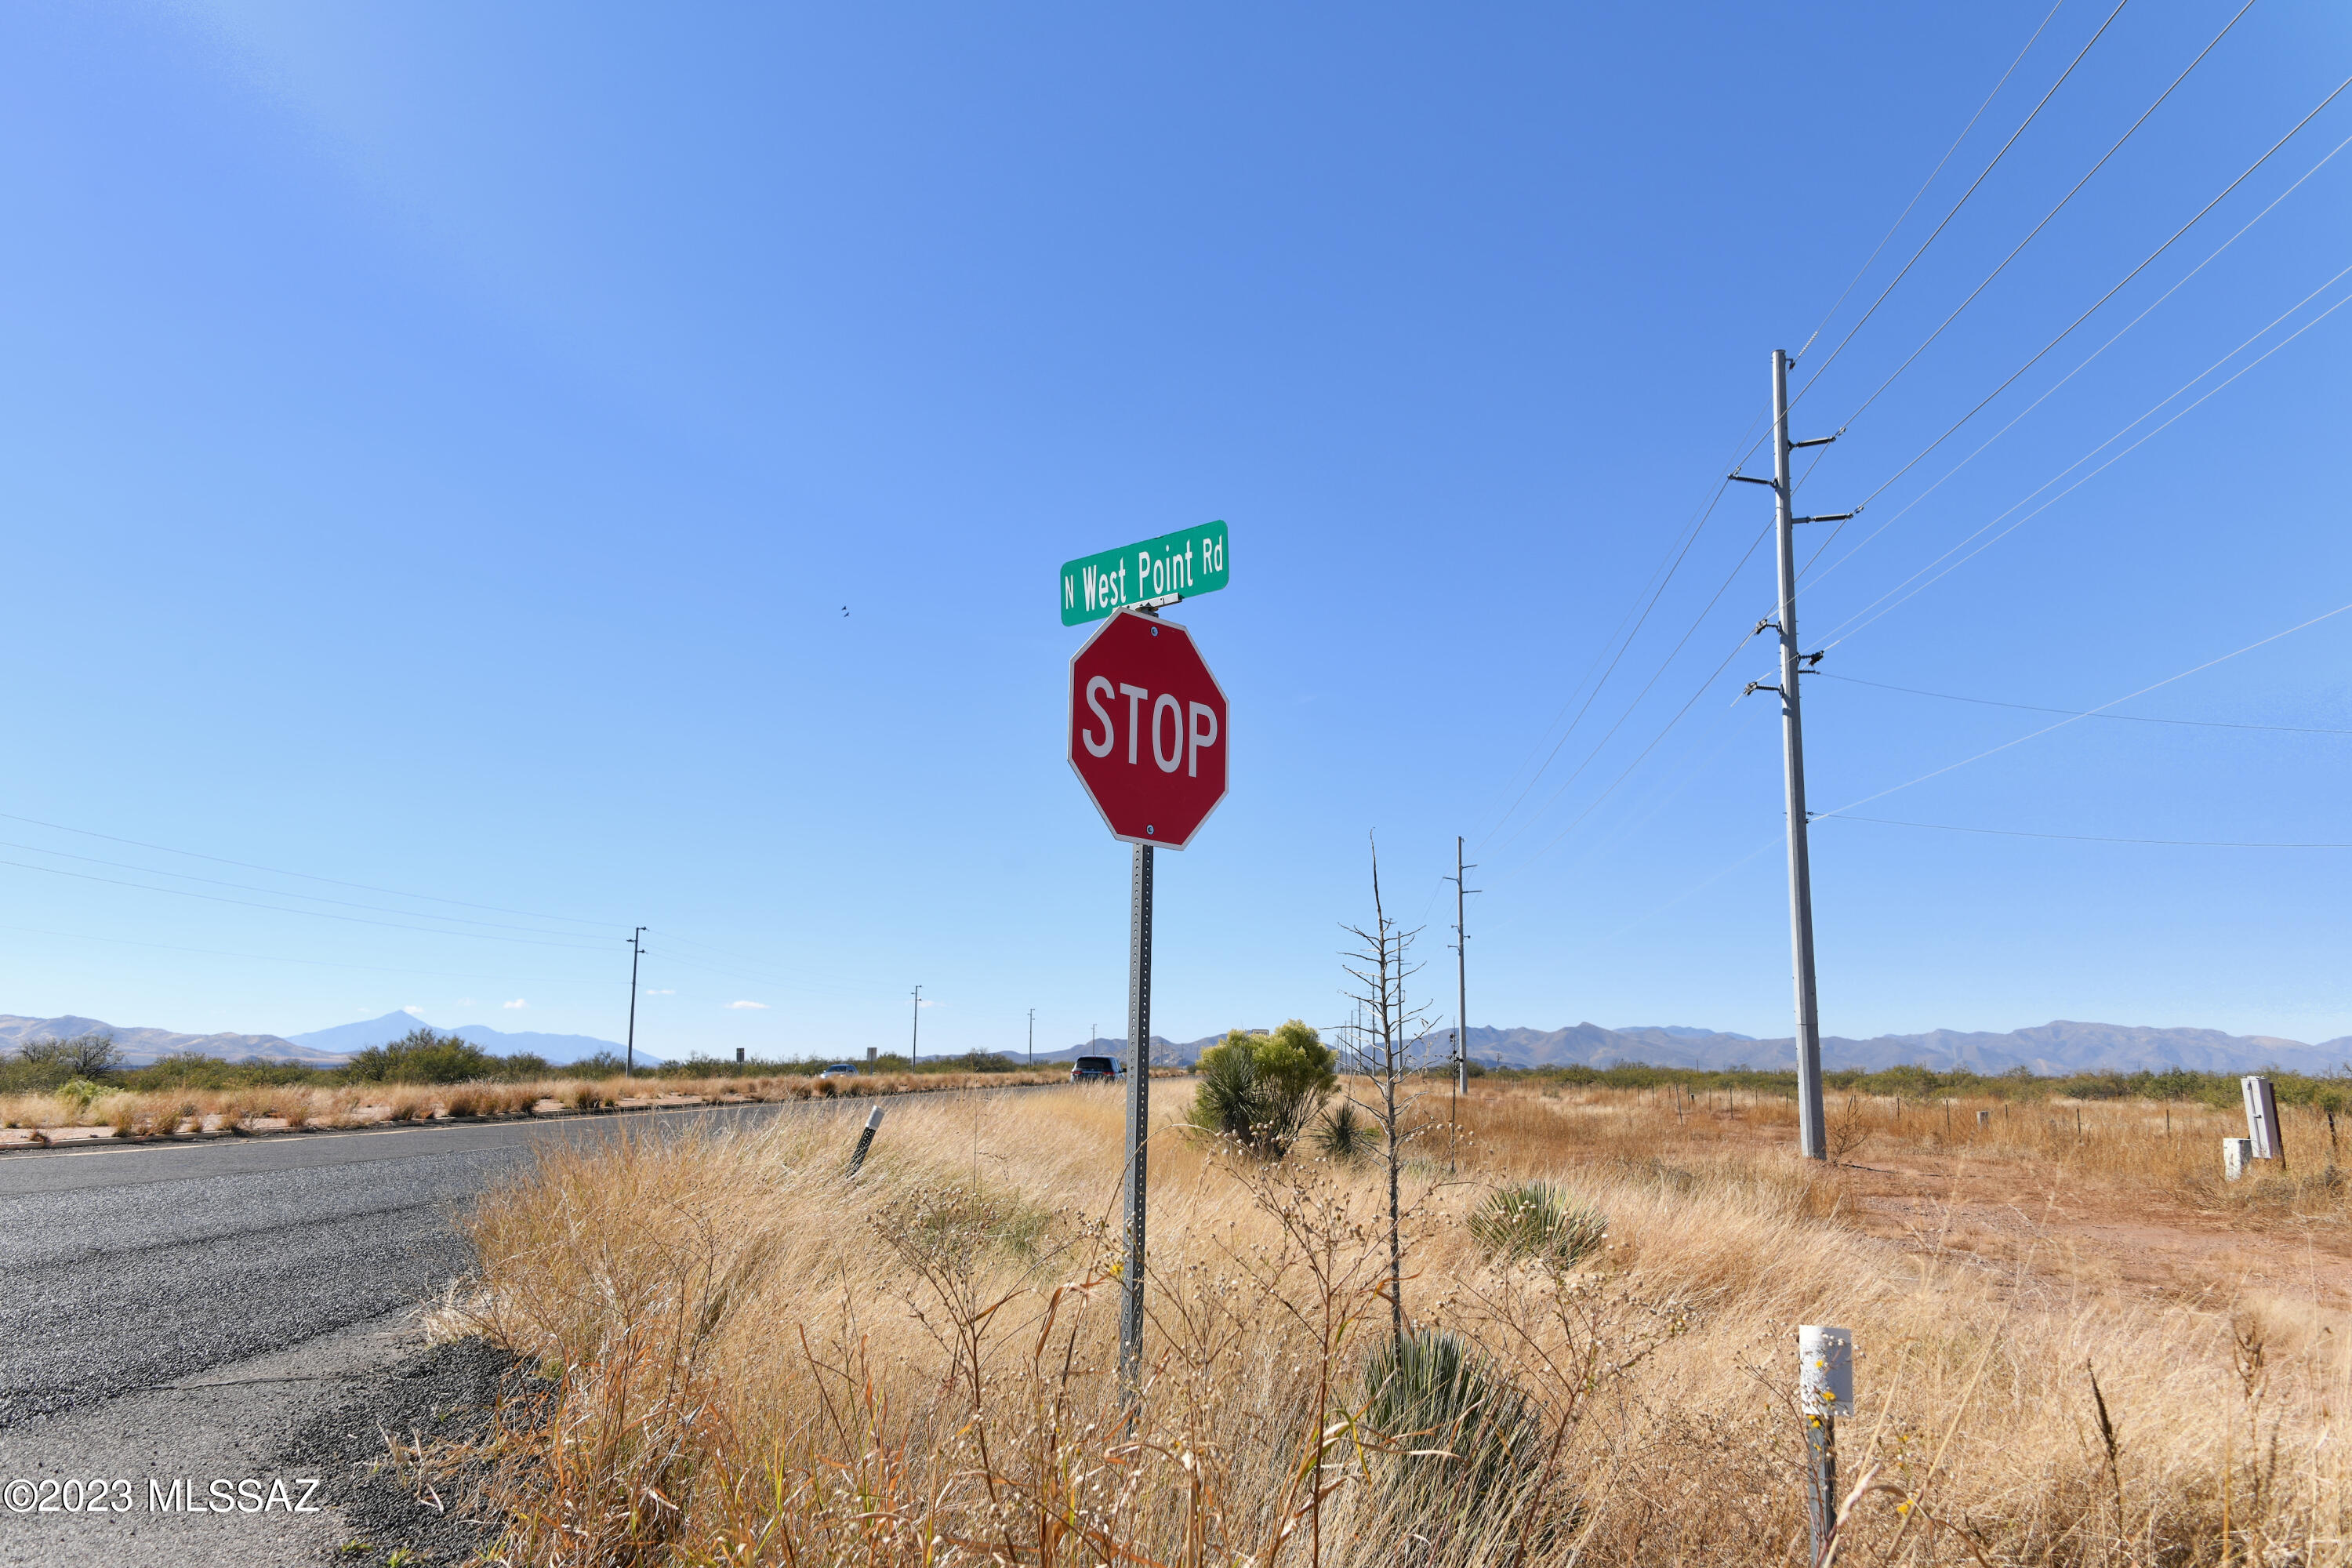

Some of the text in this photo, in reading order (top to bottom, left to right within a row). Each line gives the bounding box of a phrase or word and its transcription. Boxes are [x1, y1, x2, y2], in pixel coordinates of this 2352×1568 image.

[1065, 535, 1223, 612] N West Point Rd
[1083, 675, 1218, 778] STOP
